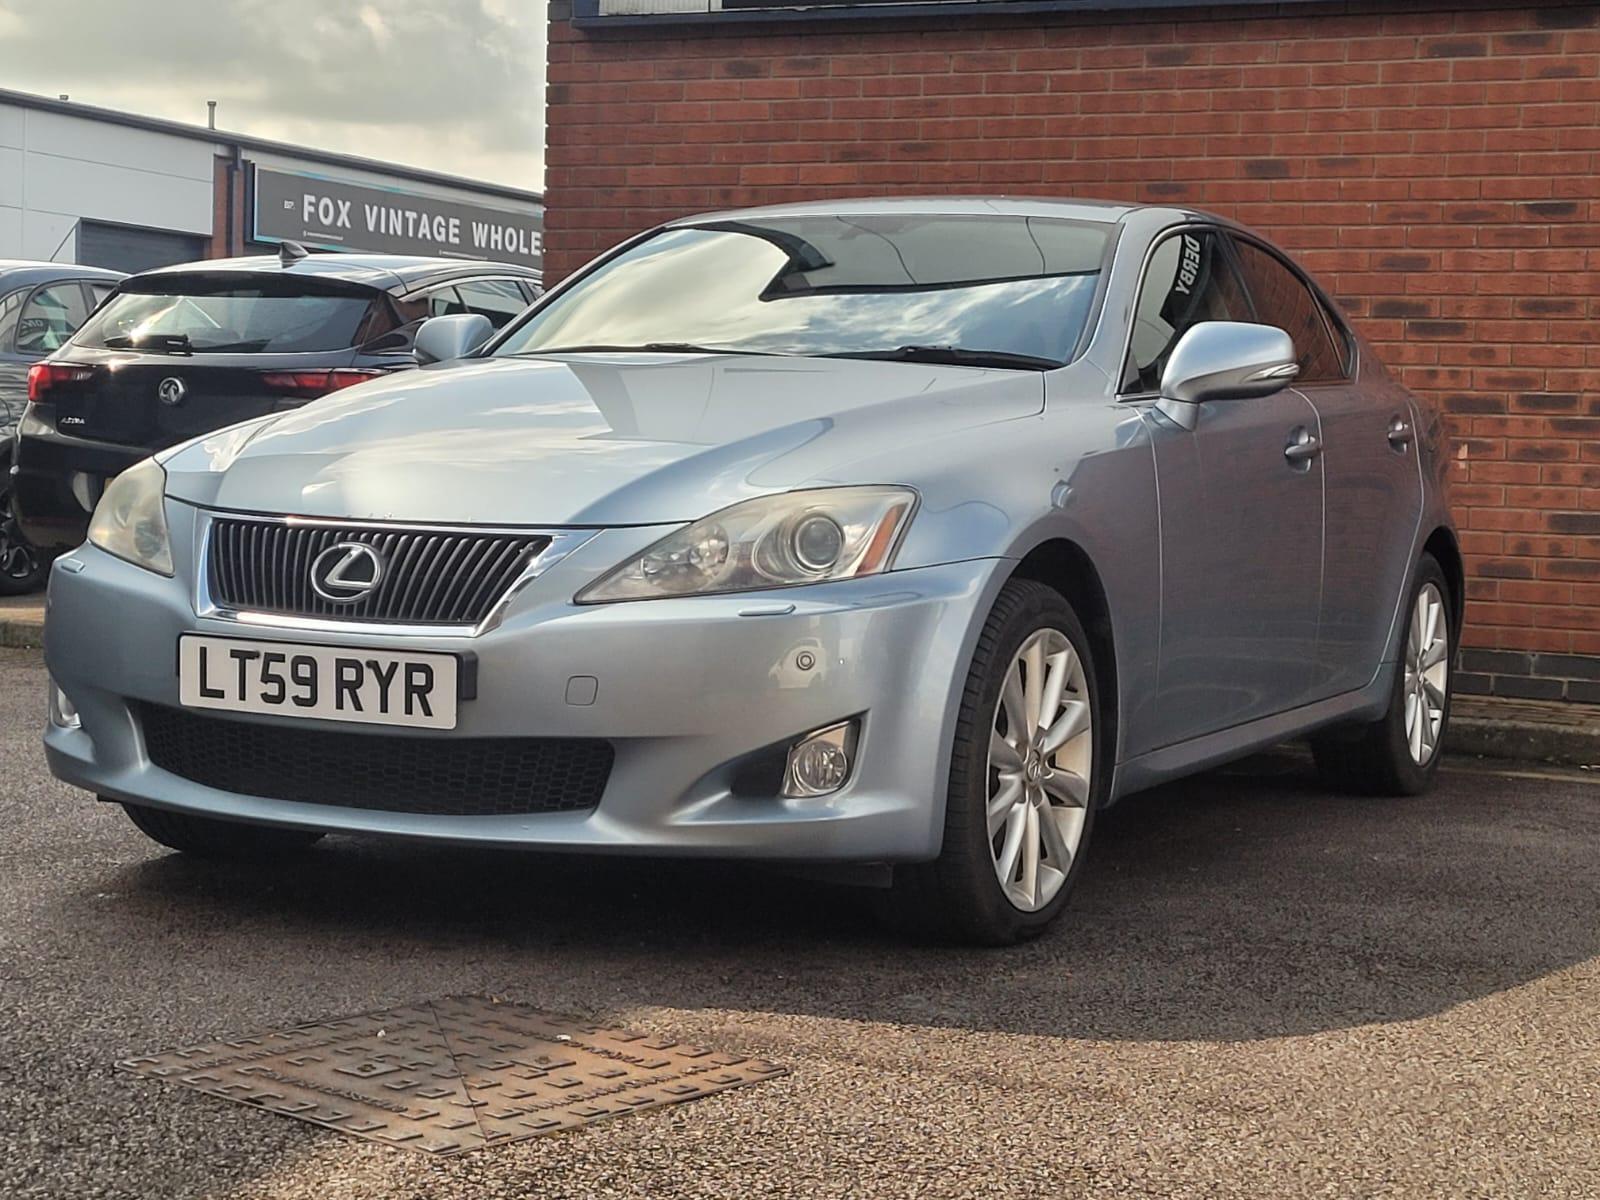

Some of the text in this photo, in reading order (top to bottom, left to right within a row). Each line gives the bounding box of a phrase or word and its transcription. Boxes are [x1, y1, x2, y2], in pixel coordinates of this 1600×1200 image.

[303, 193, 351, 229] FOX
[364, 203, 461, 245] VINTAGE
[199, 645, 434, 718] LT59 RYR
